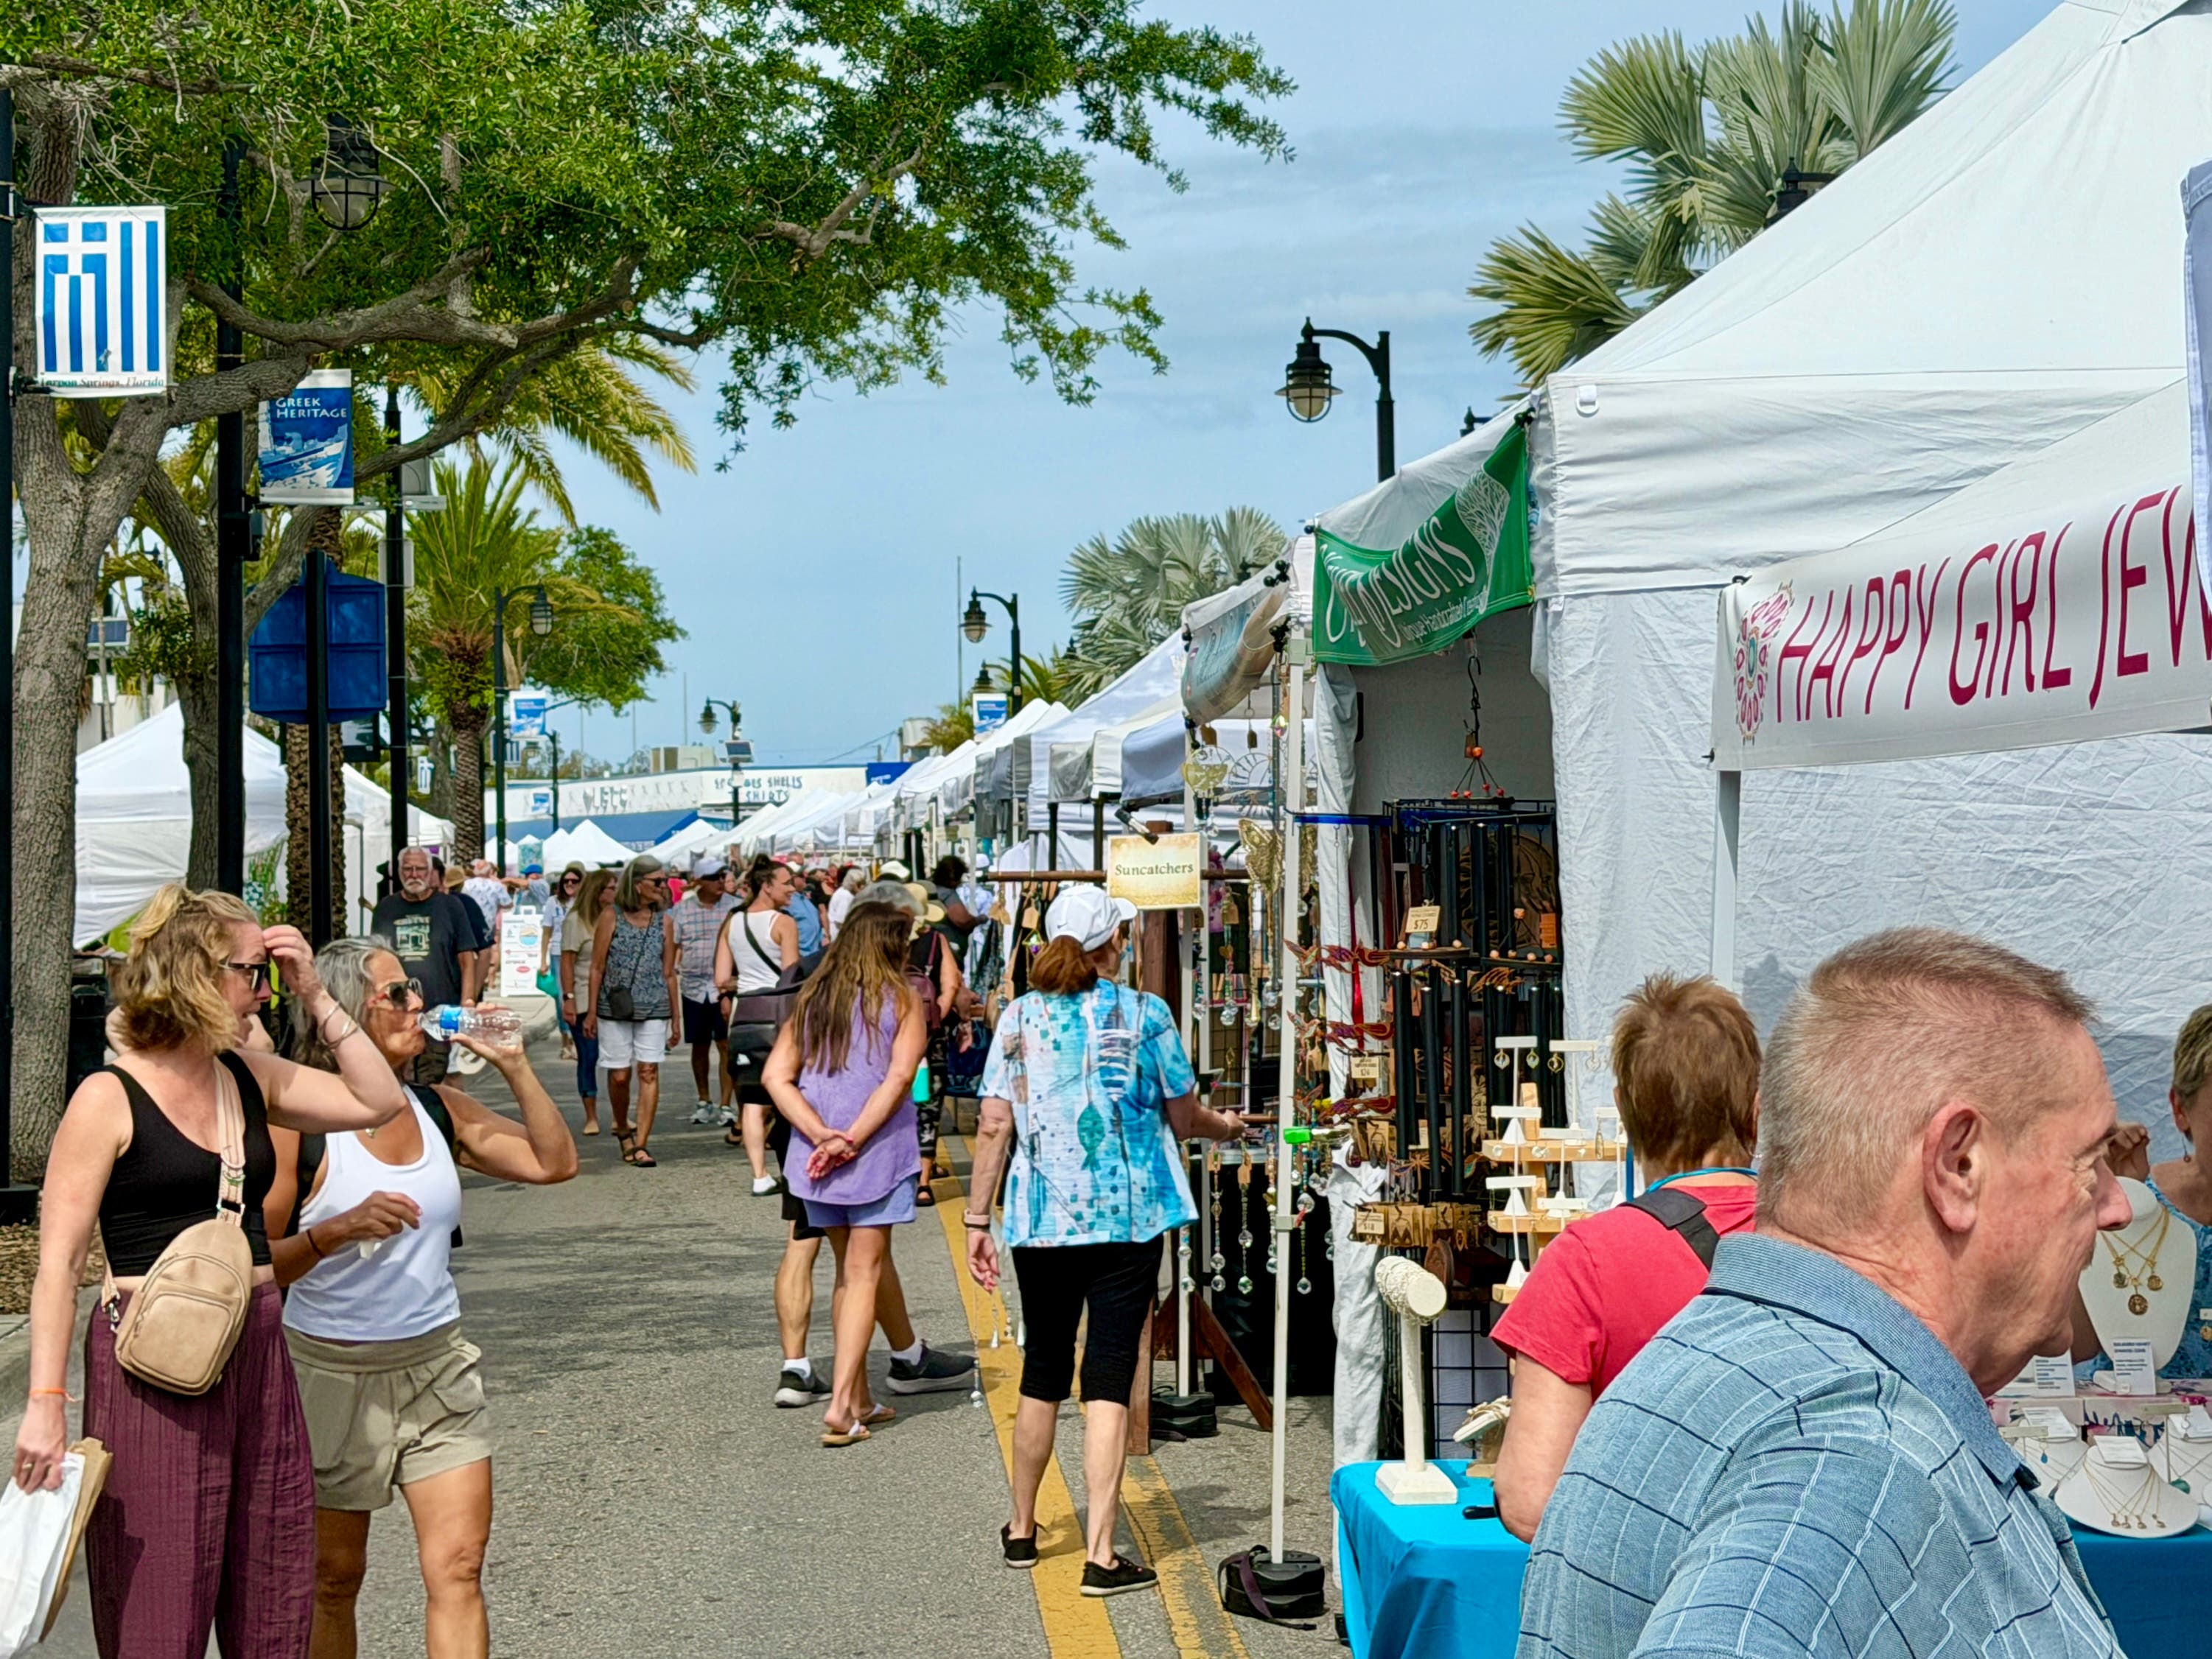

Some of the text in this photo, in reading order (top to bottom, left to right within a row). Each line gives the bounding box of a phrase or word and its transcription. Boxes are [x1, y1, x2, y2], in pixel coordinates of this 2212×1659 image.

[276, 397, 321, 408] GREEK
[276, 407, 347, 418] HERITAGE
[1777, 555, 1951, 723] HAPPY
[1948, 521, 2073, 706] GIRL
[1115, 862, 1194, 876] Suncatchers
